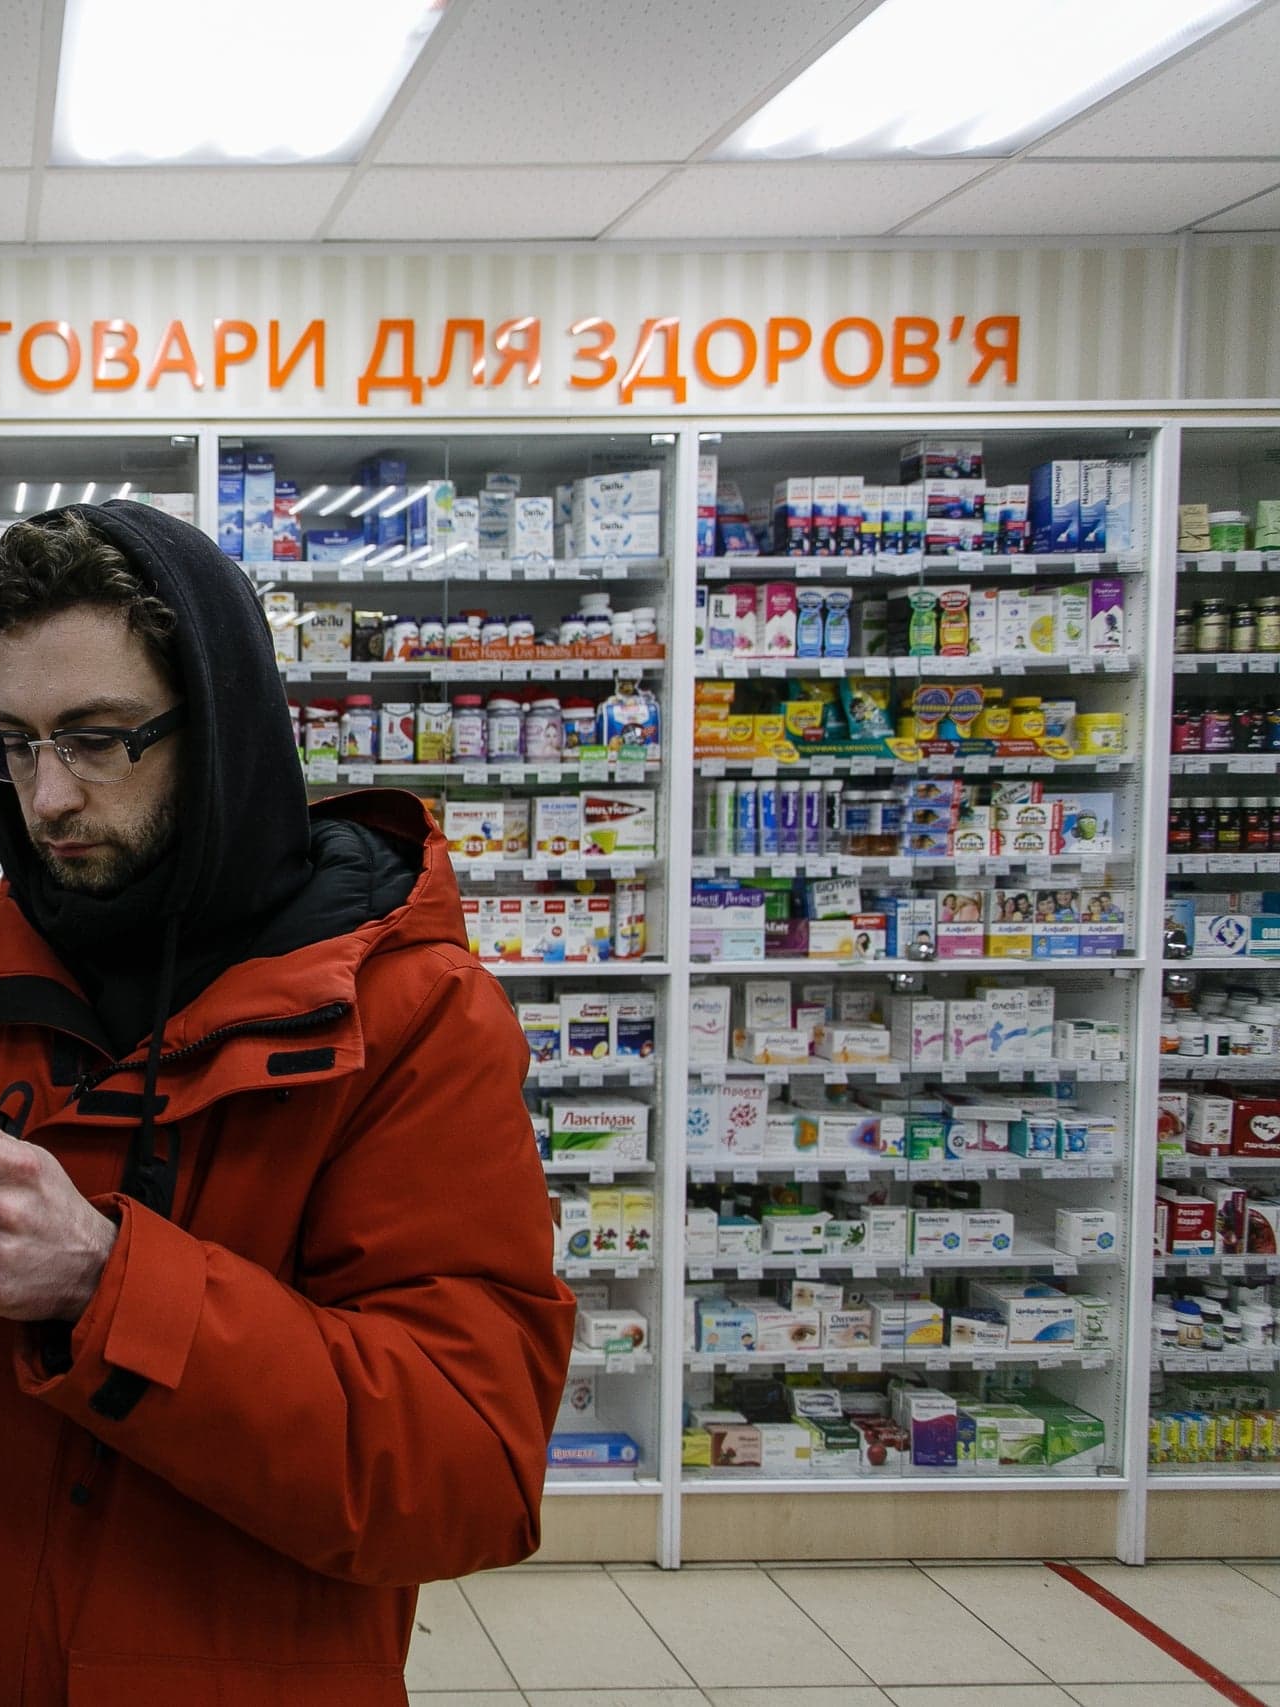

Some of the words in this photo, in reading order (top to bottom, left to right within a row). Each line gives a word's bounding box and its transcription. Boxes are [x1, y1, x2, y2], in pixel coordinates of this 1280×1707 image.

[357, 317, 542, 407] ДЛЯ
[569, 316, 1020, 405] ЗДОРОВ'Я
[562, 1112, 636, 1126] Лактімак
